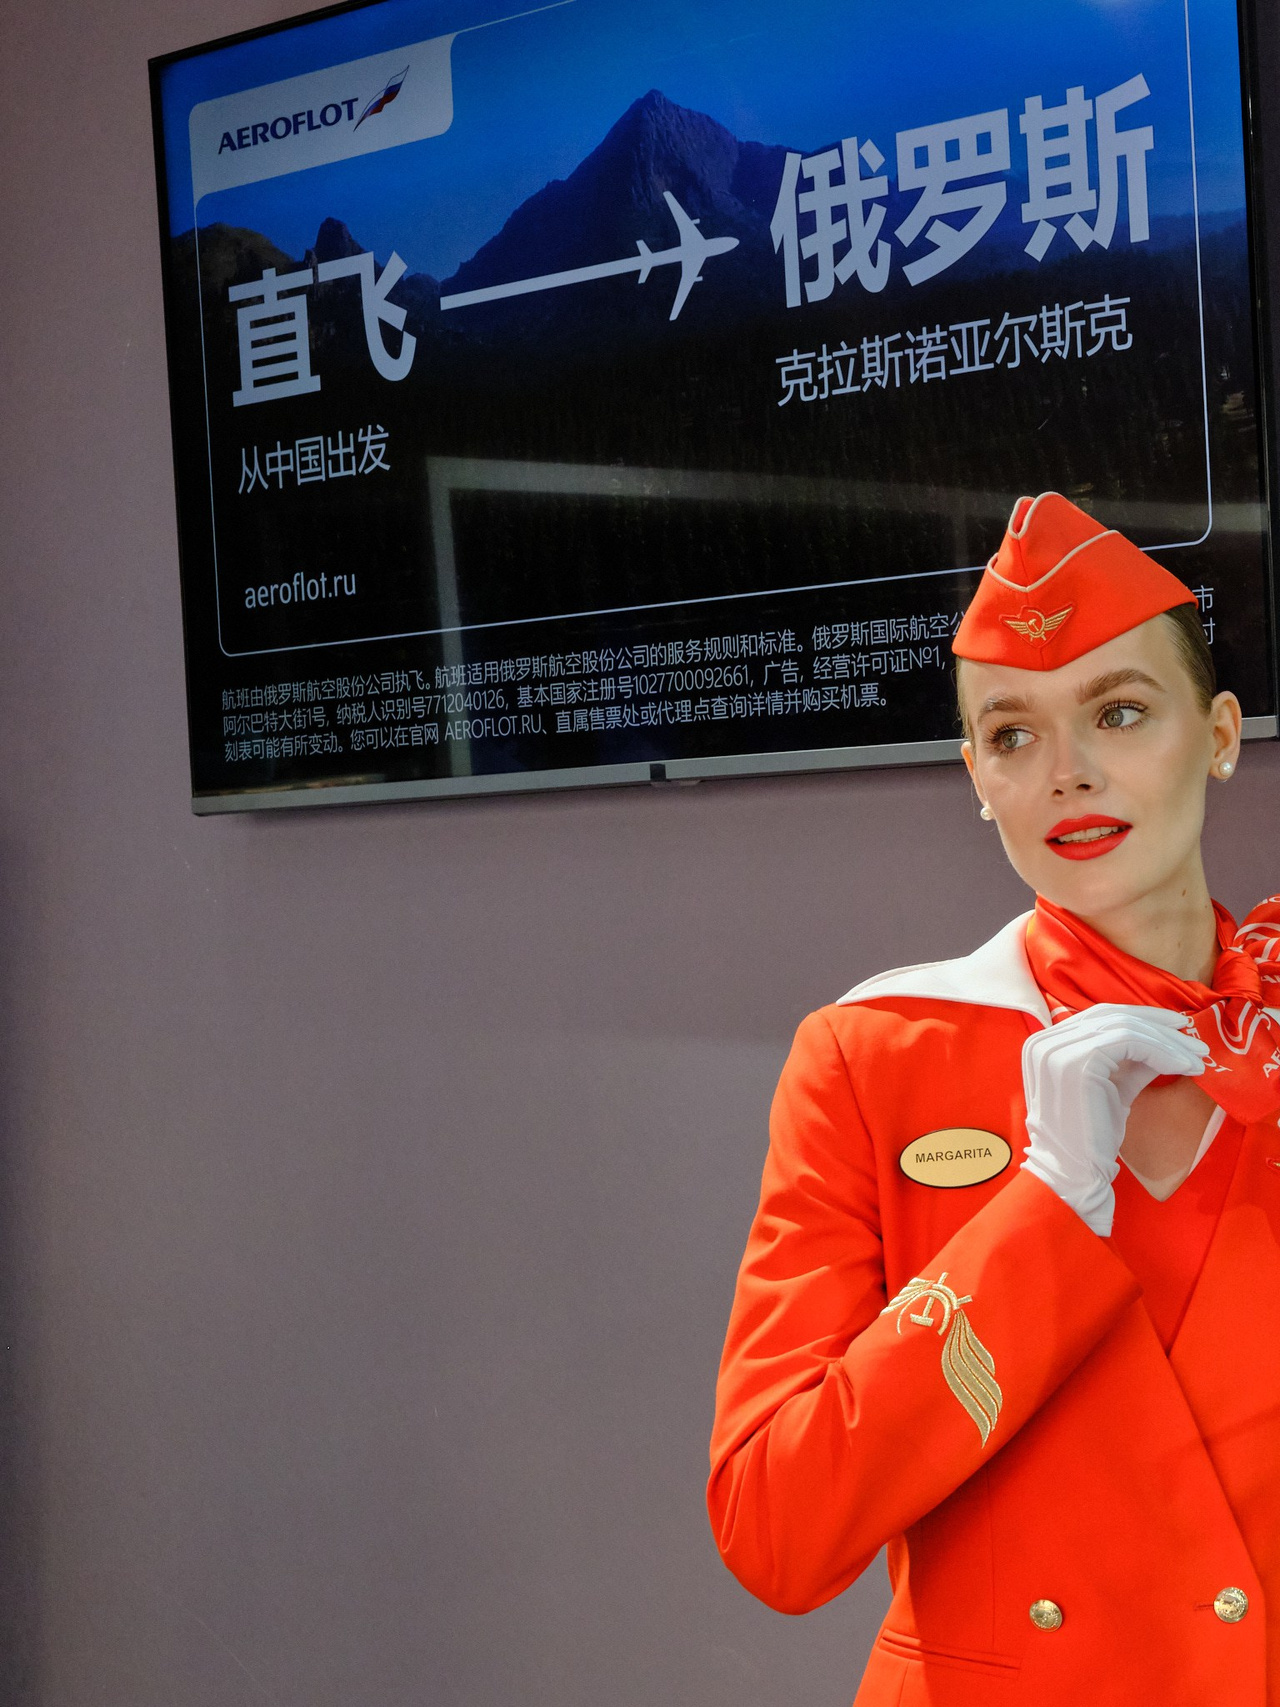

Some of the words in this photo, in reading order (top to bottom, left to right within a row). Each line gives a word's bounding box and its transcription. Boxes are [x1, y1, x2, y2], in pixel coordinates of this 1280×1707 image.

[217, 97, 359, 155] AEROFLOT
[228, 250, 417, 407] 直飞
[769, 72, 1154, 309] 俄罗斯
[775, 293, 1133, 407] 克拉斯诺亚尔斯克
[238, 424, 391, 495] 从中国出发
[244, 571, 357, 610] aeroflot.ru
[1192, 584, 1214, 613] 市
[915, 1147, 993, 1164] MARGARITA
